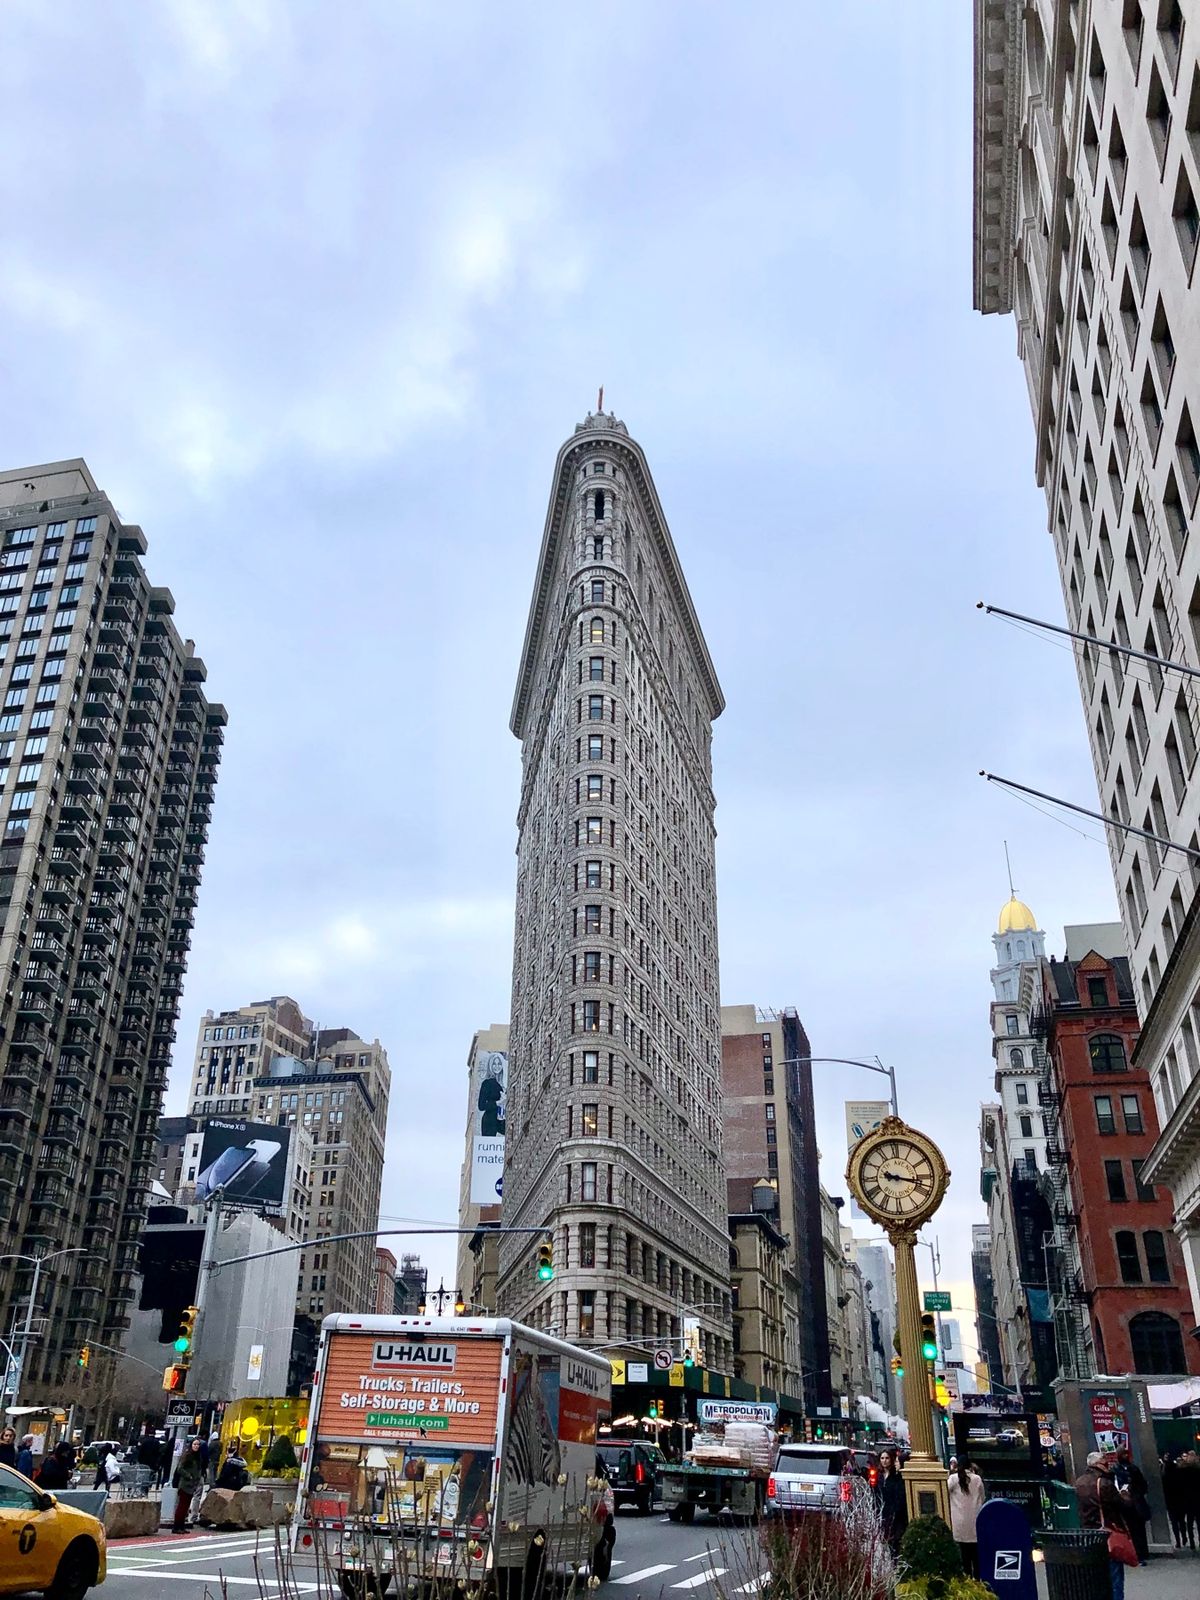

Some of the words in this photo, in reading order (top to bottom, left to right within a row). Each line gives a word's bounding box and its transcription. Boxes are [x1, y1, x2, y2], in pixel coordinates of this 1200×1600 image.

[215, 1121, 234, 1130] iPhone
[884, 1185, 913, 1197] BUILDING
[376, 1345, 453, 1363] U-HAUL
[567, 1362, 598, 1391] U-HAUL
[359, 1375, 407, 1394] Trucks,
[411, 1377, 465, 1396] Trailers,
[340, 1392, 425, 1414] Self-Storage
[429, 1397, 440, 1412] &
[444, 1397, 480, 1414] More
[1094, 1404, 1110, 1412] Gifts
[705, 1405, 771, 1421] METROPOLITAN
[382, 1415, 444, 1428] uhaul.com
[1006, 1490, 1033, 1498] Station
